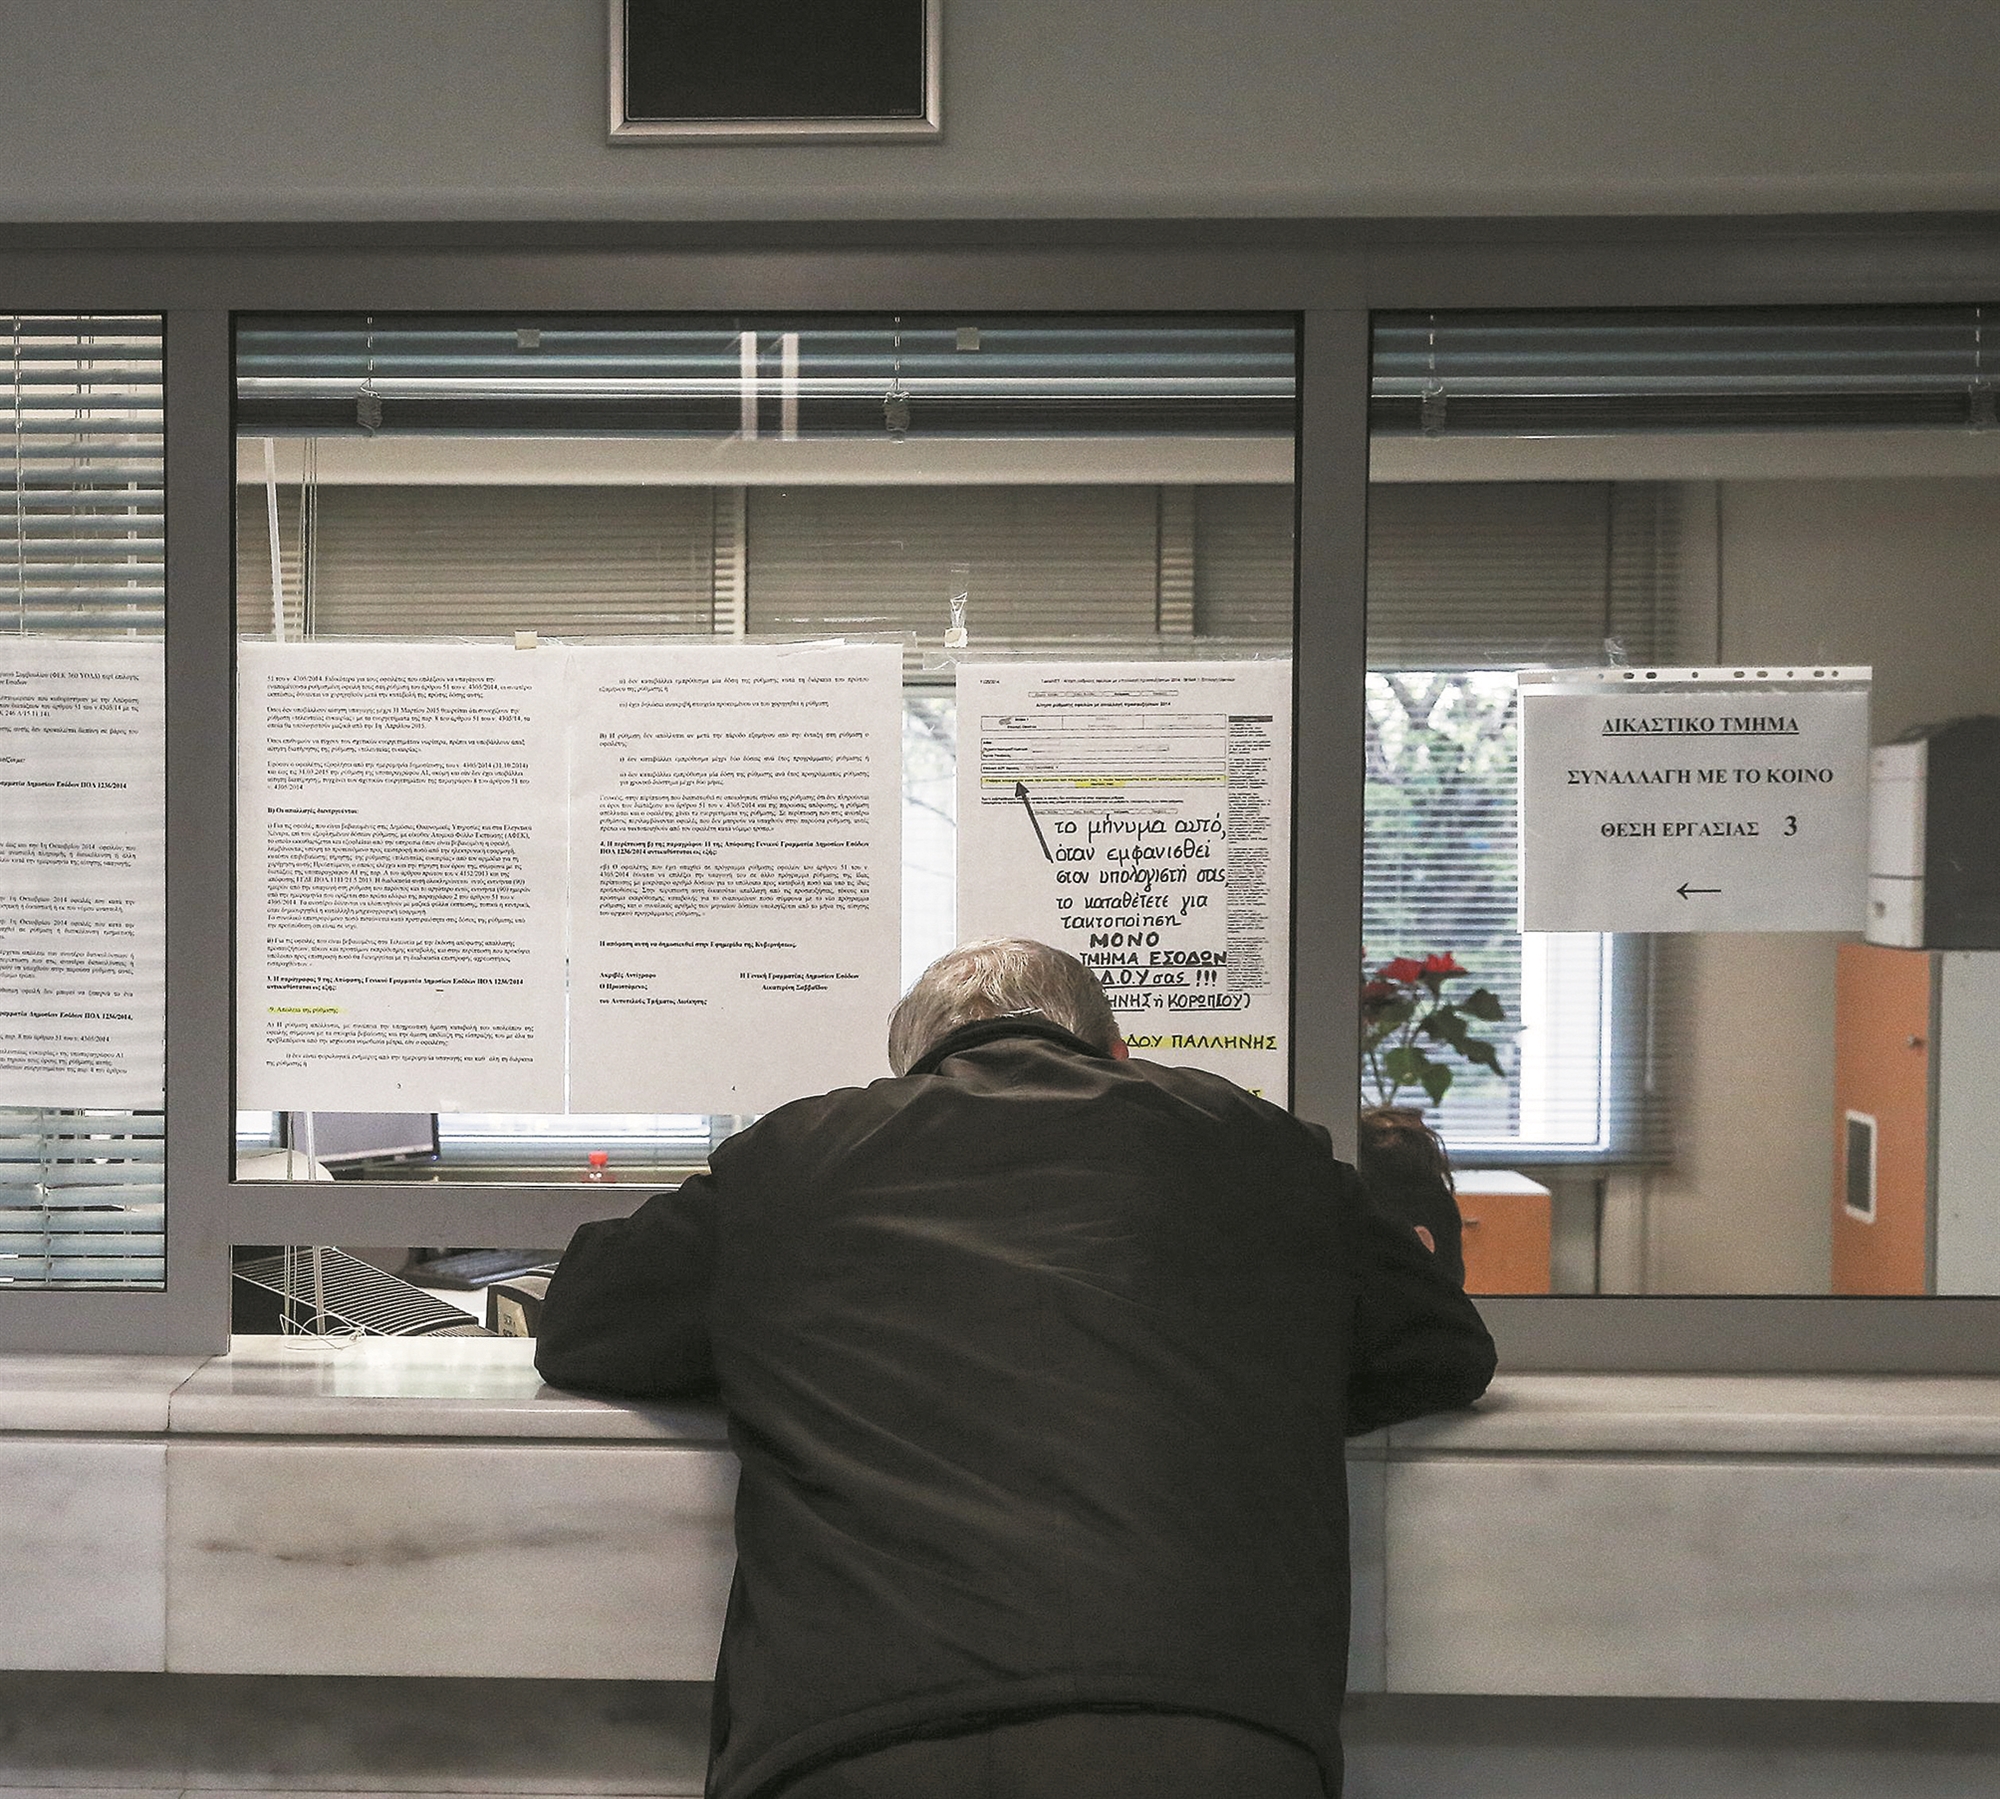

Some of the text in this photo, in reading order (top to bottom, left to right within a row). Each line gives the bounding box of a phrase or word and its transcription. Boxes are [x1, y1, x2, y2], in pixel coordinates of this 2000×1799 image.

[1602, 717, 1798, 732] ΔΙΚΑΣΤΙΚΟ ΤΜΗΜΑ
[1568, 768, 1833, 784] ΣΥΝΑΛΛΑΓΗ ΜΕ ΤΟ ΚΟΙΝΟ
[1055, 814, 1227, 843] το μήνυμα αυτό,
[1601, 816, 1798, 838] ΘΕΣΗ ΕΡΓΑΣΙΑΣ 3
[1056, 838, 1210, 865] όταν εμφανισθεί
[1056, 870, 1089, 883] στον
[1100, 864, 1187, 892] υπολογιστή
[1056, 891, 1208, 915] το καταθέτετε για
[1061, 914, 1181, 929] τακτοποίηση
[1090, 932, 1159, 948] ΜΟΝΟ
[1080, 951, 1227, 965] ΤΜΗΜΑ ΕΣΟΔΩΝ
[1107, 993, 1152, 1008] ΗΝΗΣ
[1172, 1034, 1277, 1049] ΠΑΛΛΗΝΗΣ
